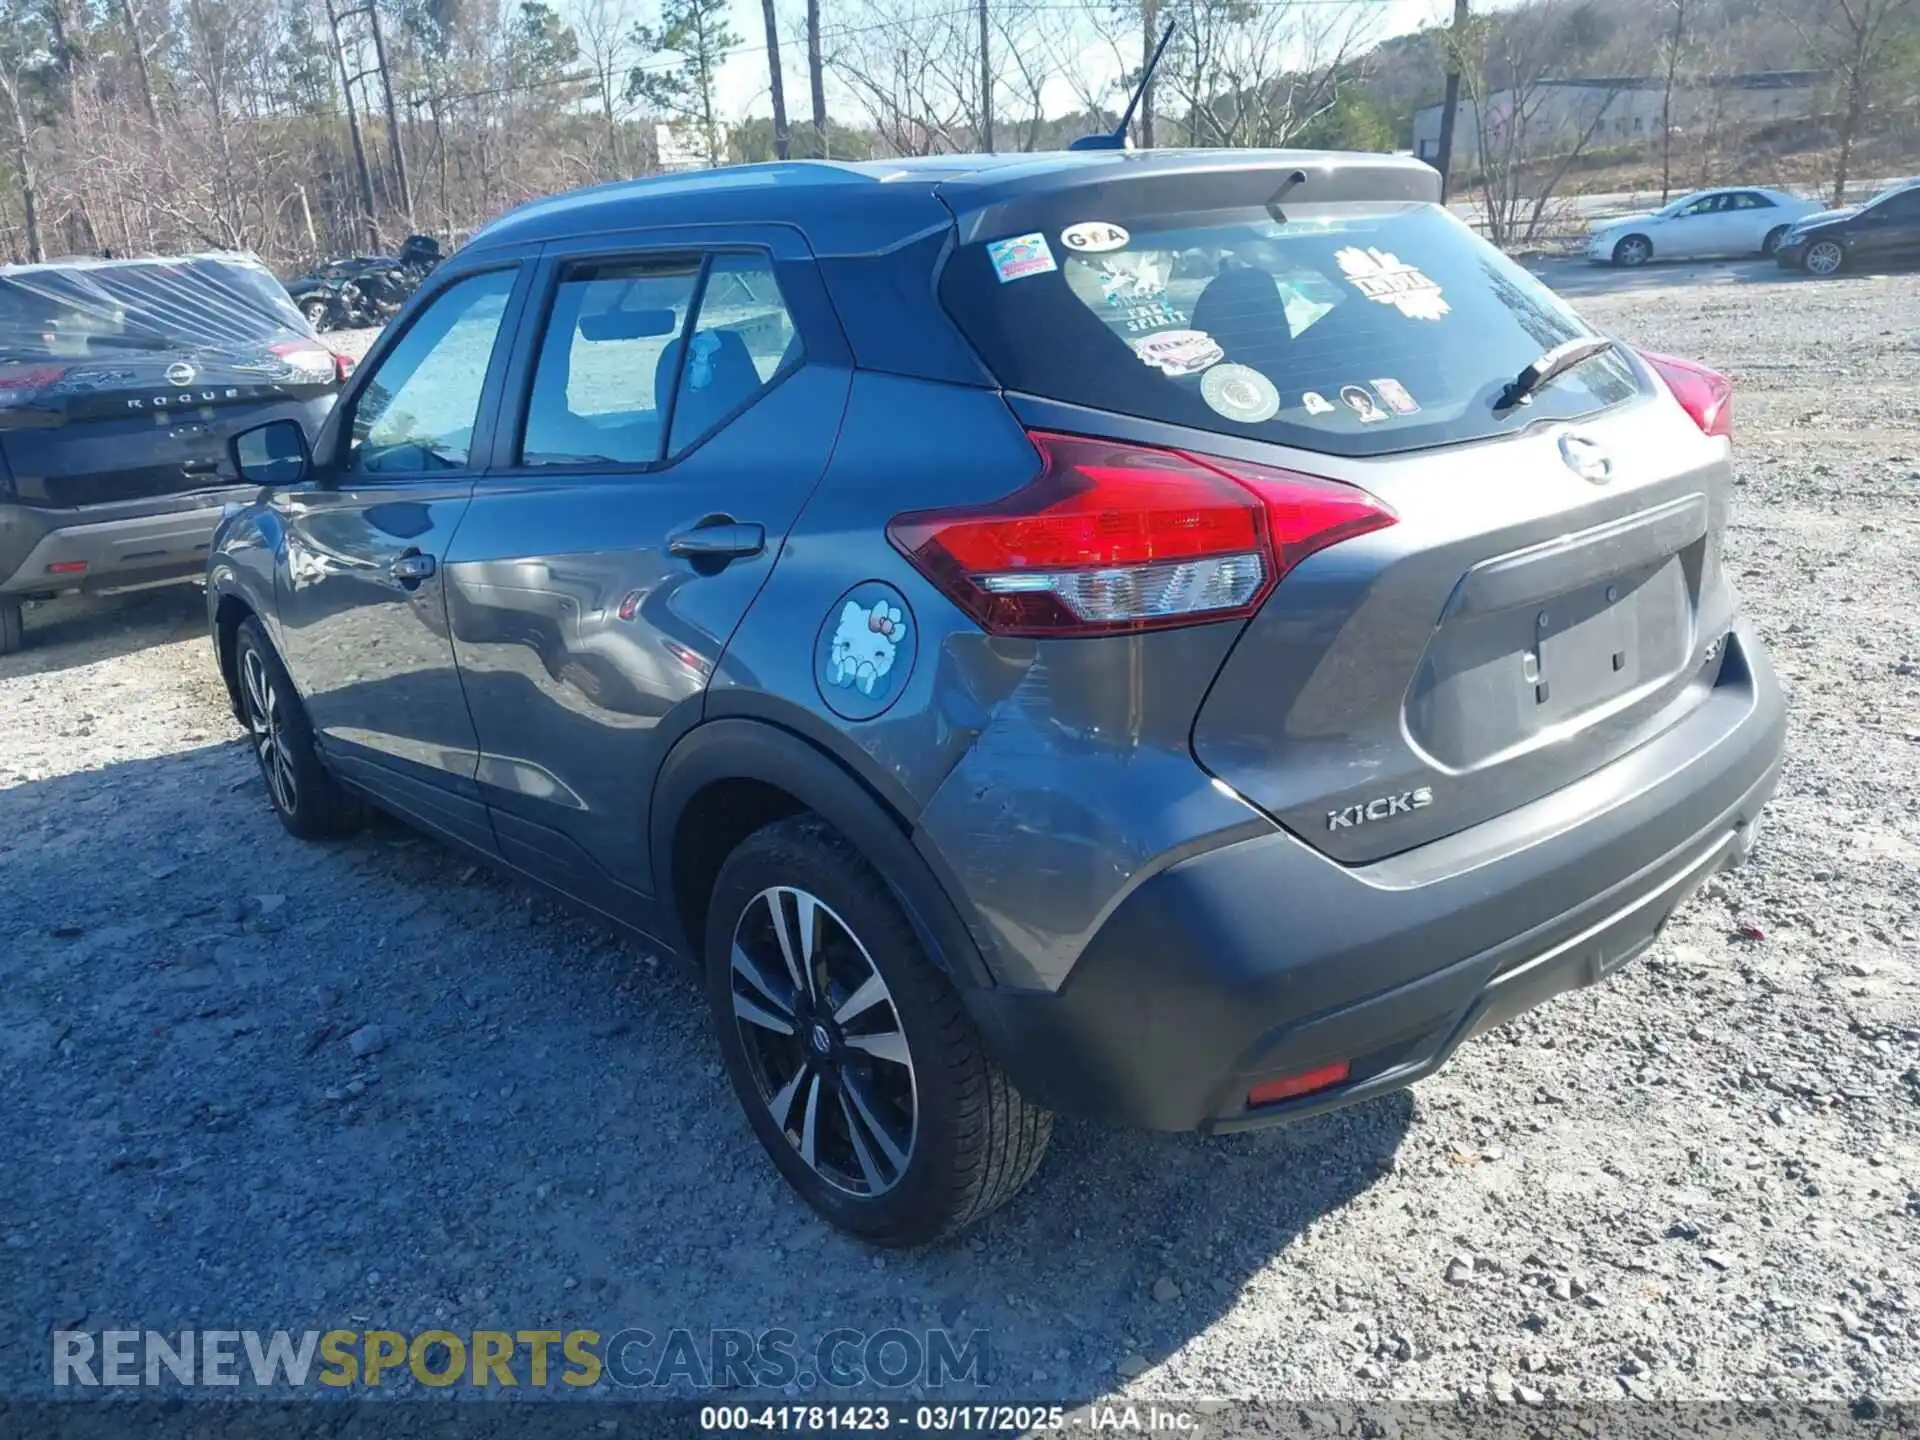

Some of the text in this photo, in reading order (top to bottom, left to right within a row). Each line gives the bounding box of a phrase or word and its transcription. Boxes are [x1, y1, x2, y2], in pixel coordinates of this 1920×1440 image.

[1126, 311, 1188, 332] SPIRIT
[127, 388, 238, 409] ROGUE
[1327, 785, 1433, 832] KICKS
